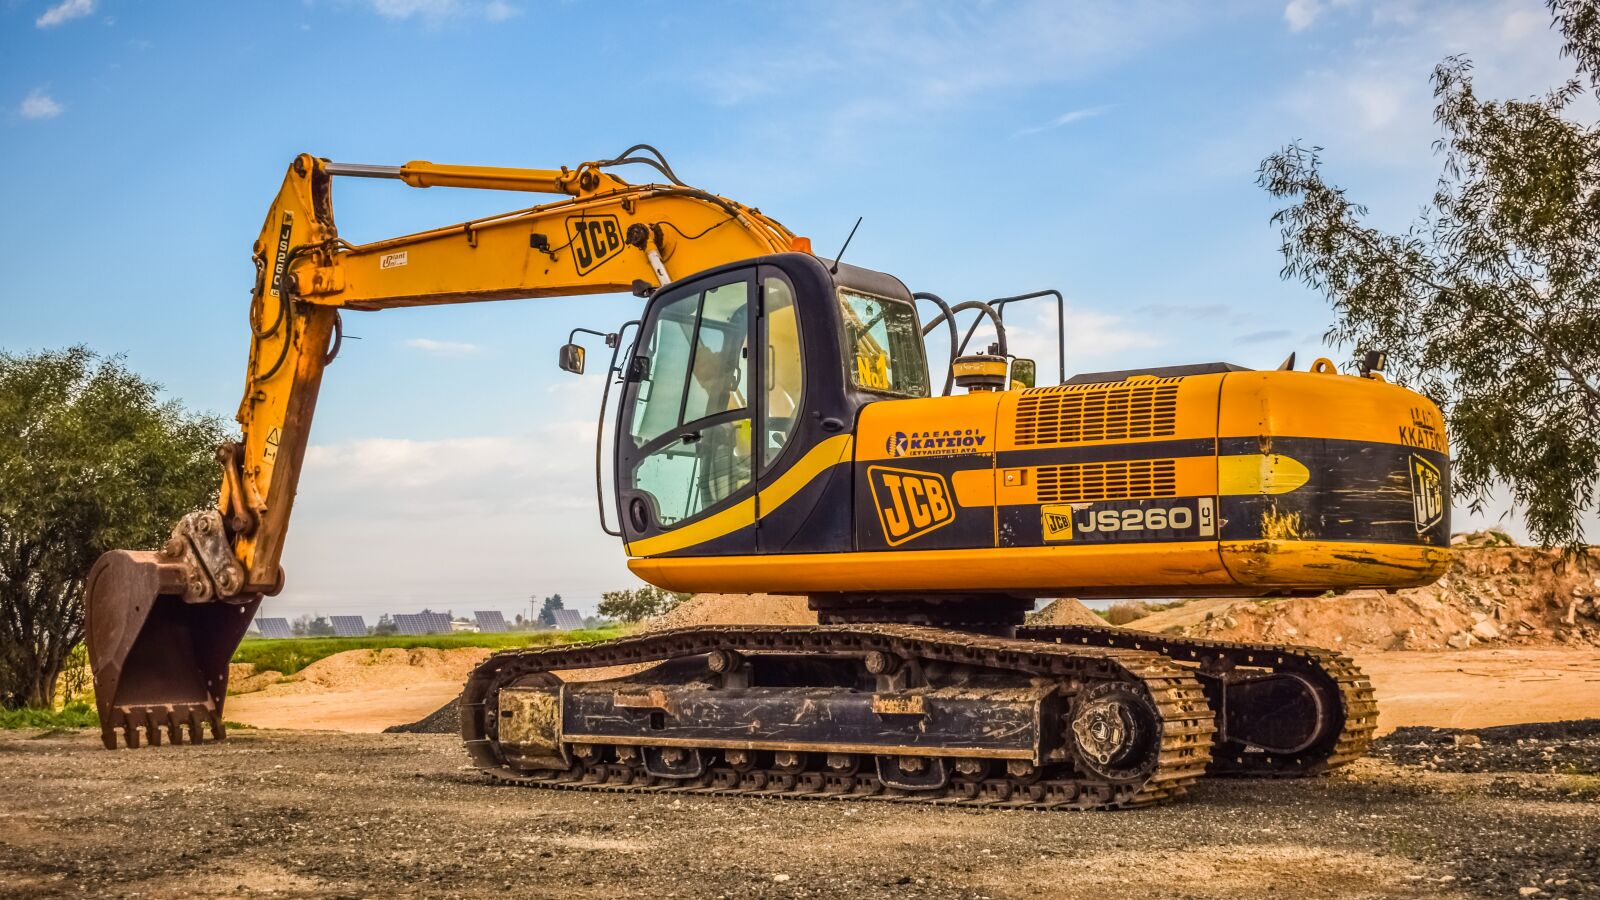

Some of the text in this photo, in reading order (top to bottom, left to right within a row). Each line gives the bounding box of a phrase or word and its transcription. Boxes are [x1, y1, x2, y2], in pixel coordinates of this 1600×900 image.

[574, 220, 620, 269] JCB
[910, 436, 986, 450] ΚΑΤΣΙΟΥ
[882, 473, 949, 537] JCB
[1049, 506, 1211, 533] JCB JS260 LC
